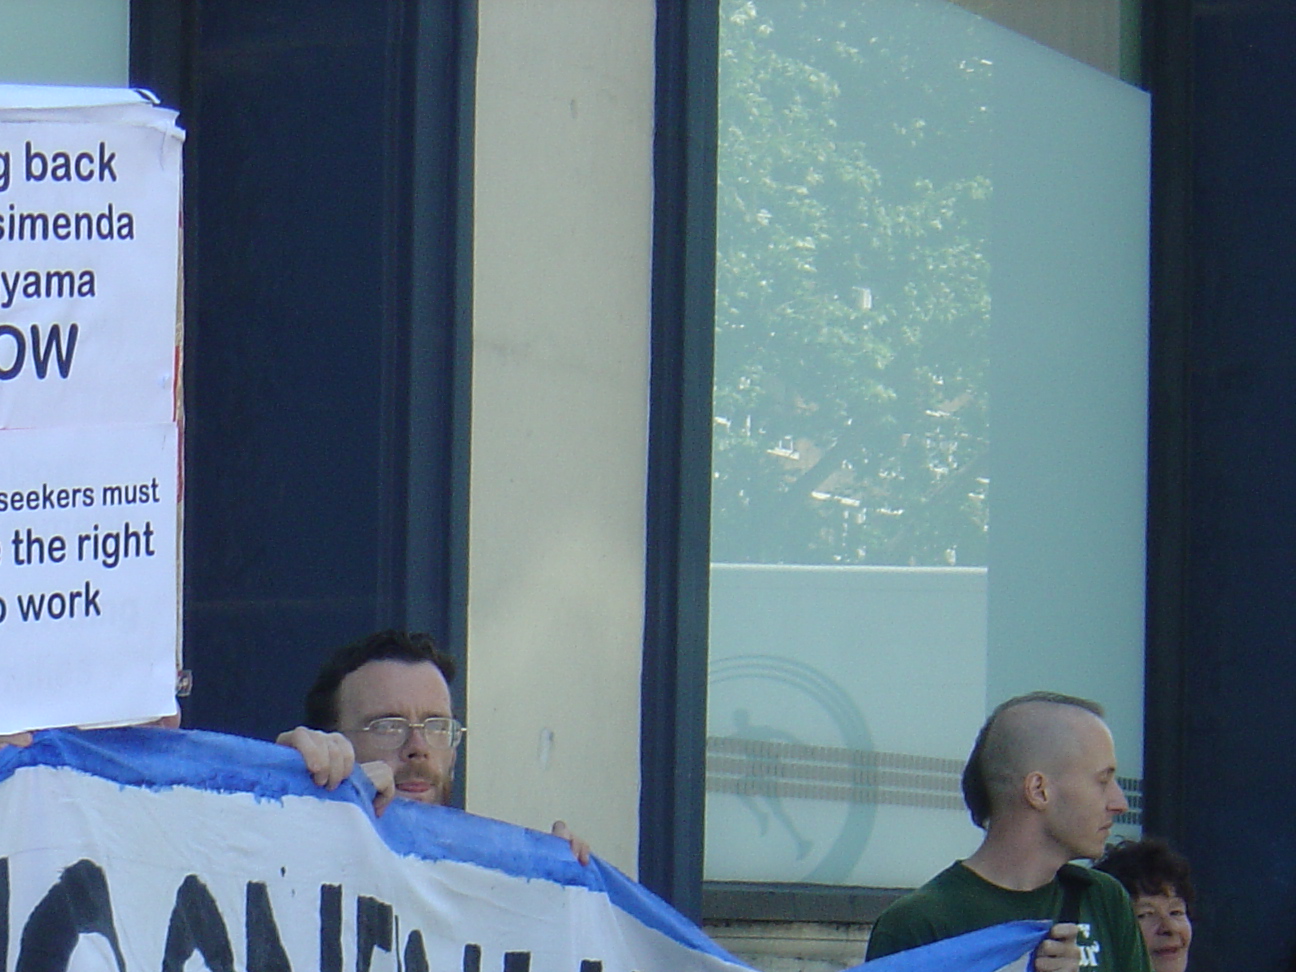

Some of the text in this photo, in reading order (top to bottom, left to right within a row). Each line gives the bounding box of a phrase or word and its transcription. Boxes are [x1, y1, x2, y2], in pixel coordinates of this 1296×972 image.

[25, 141, 117, 182] back
[102, 477, 160, 506] must
[11, 528, 66, 566] the
[77, 521, 155, 569] right
[17, 580, 101, 622] work
